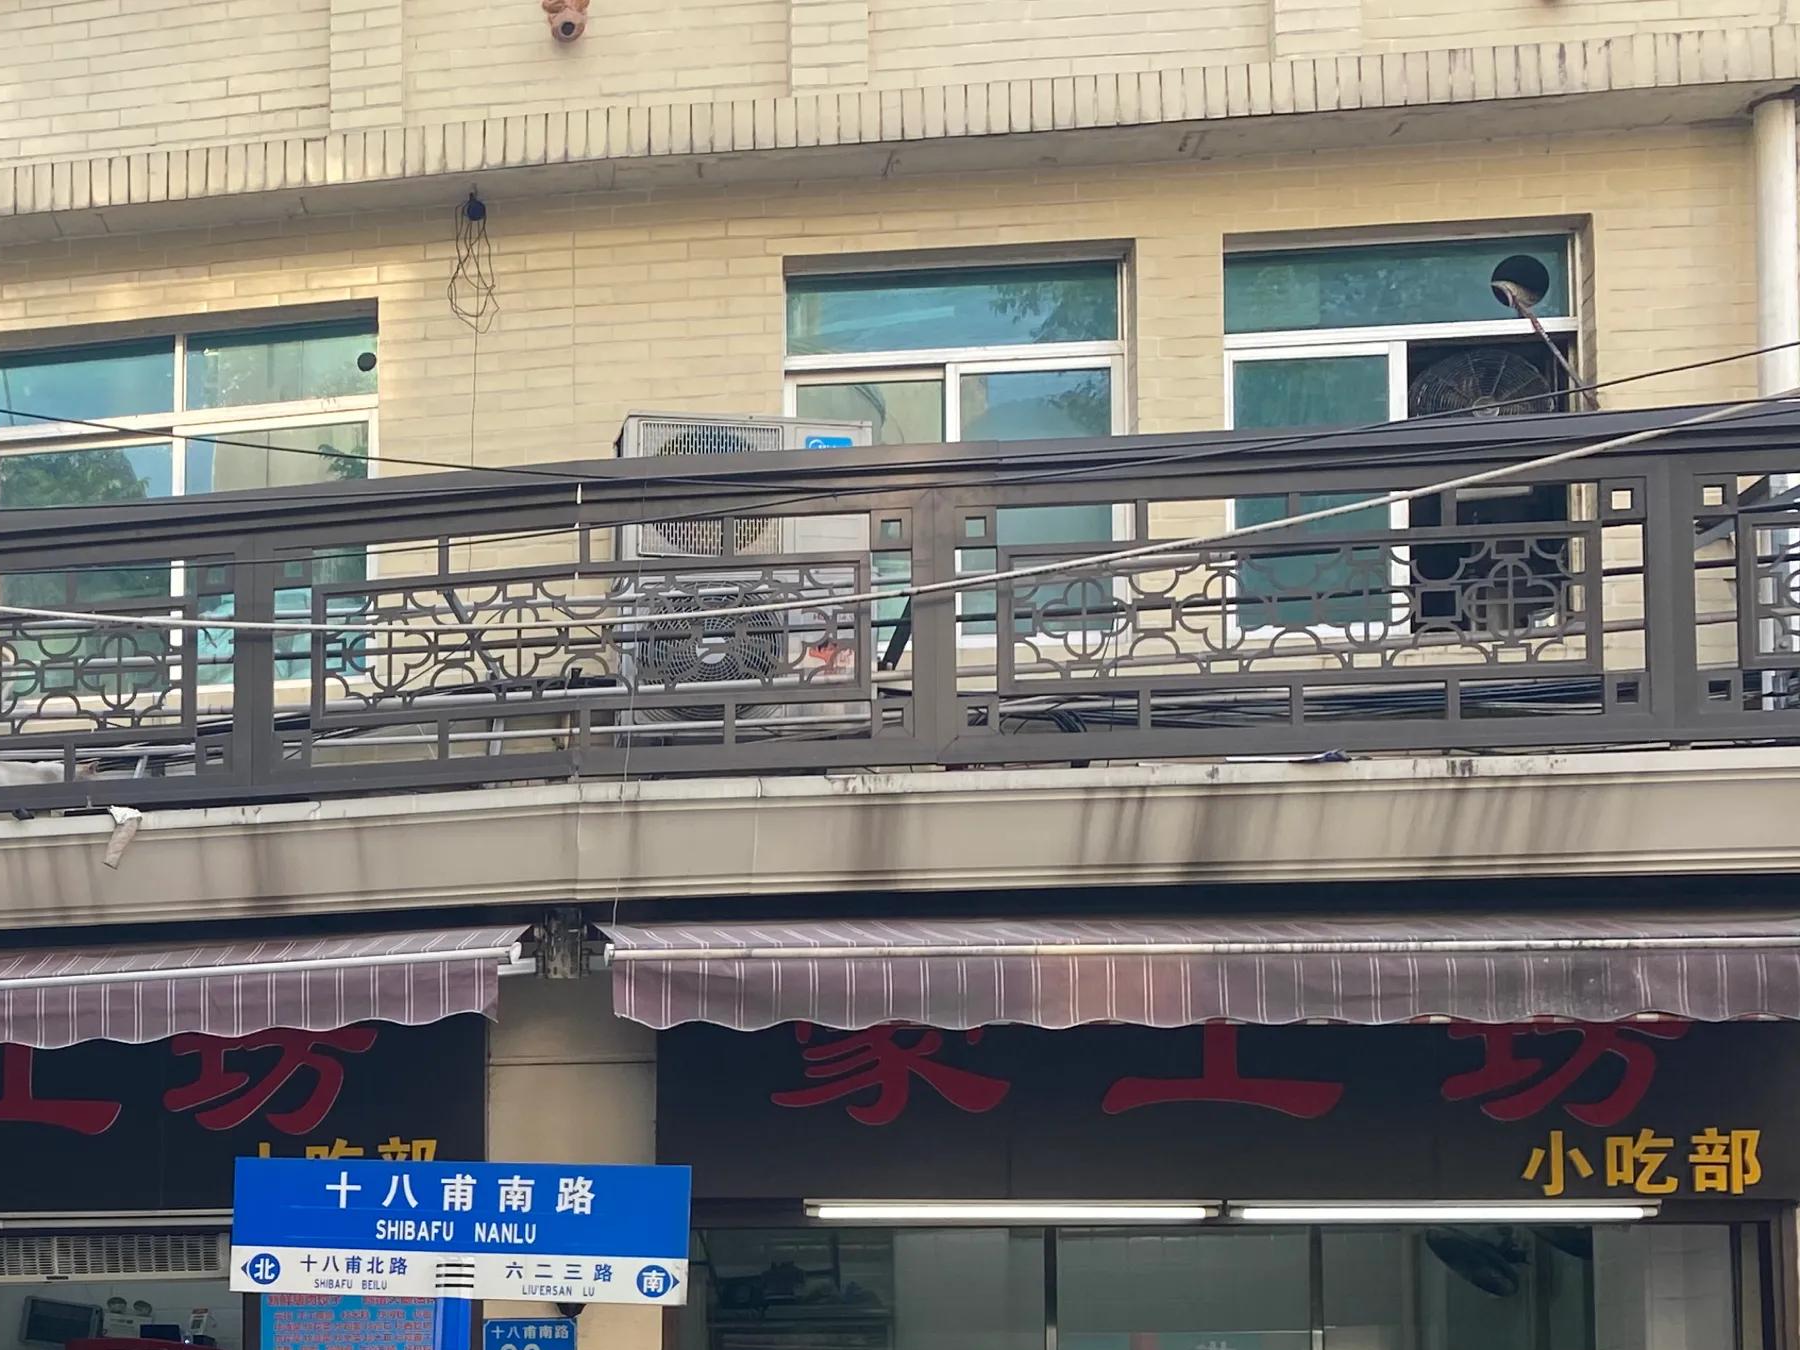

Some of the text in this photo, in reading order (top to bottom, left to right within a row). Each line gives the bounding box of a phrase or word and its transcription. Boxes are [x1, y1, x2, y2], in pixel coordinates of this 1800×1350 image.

[1520, 1126, 1764, 1197] 小吃部
[325, 1171, 596, 1215] 十八甫南路
[375, 1219, 537, 1244] SHIBAFU NANLU
[253, 1257, 276, 1280] 北
[300, 1254, 408, 1275] 十八甫北路
[505, 1261, 613, 1282] 六二三路
[314, 1278, 388, 1290] SHIBAFU BEILU
[583, 1286, 595, 1297] LU
[641, 1269, 666, 1293] 南
[491, 1325, 569, 1339] 十八甫南路
